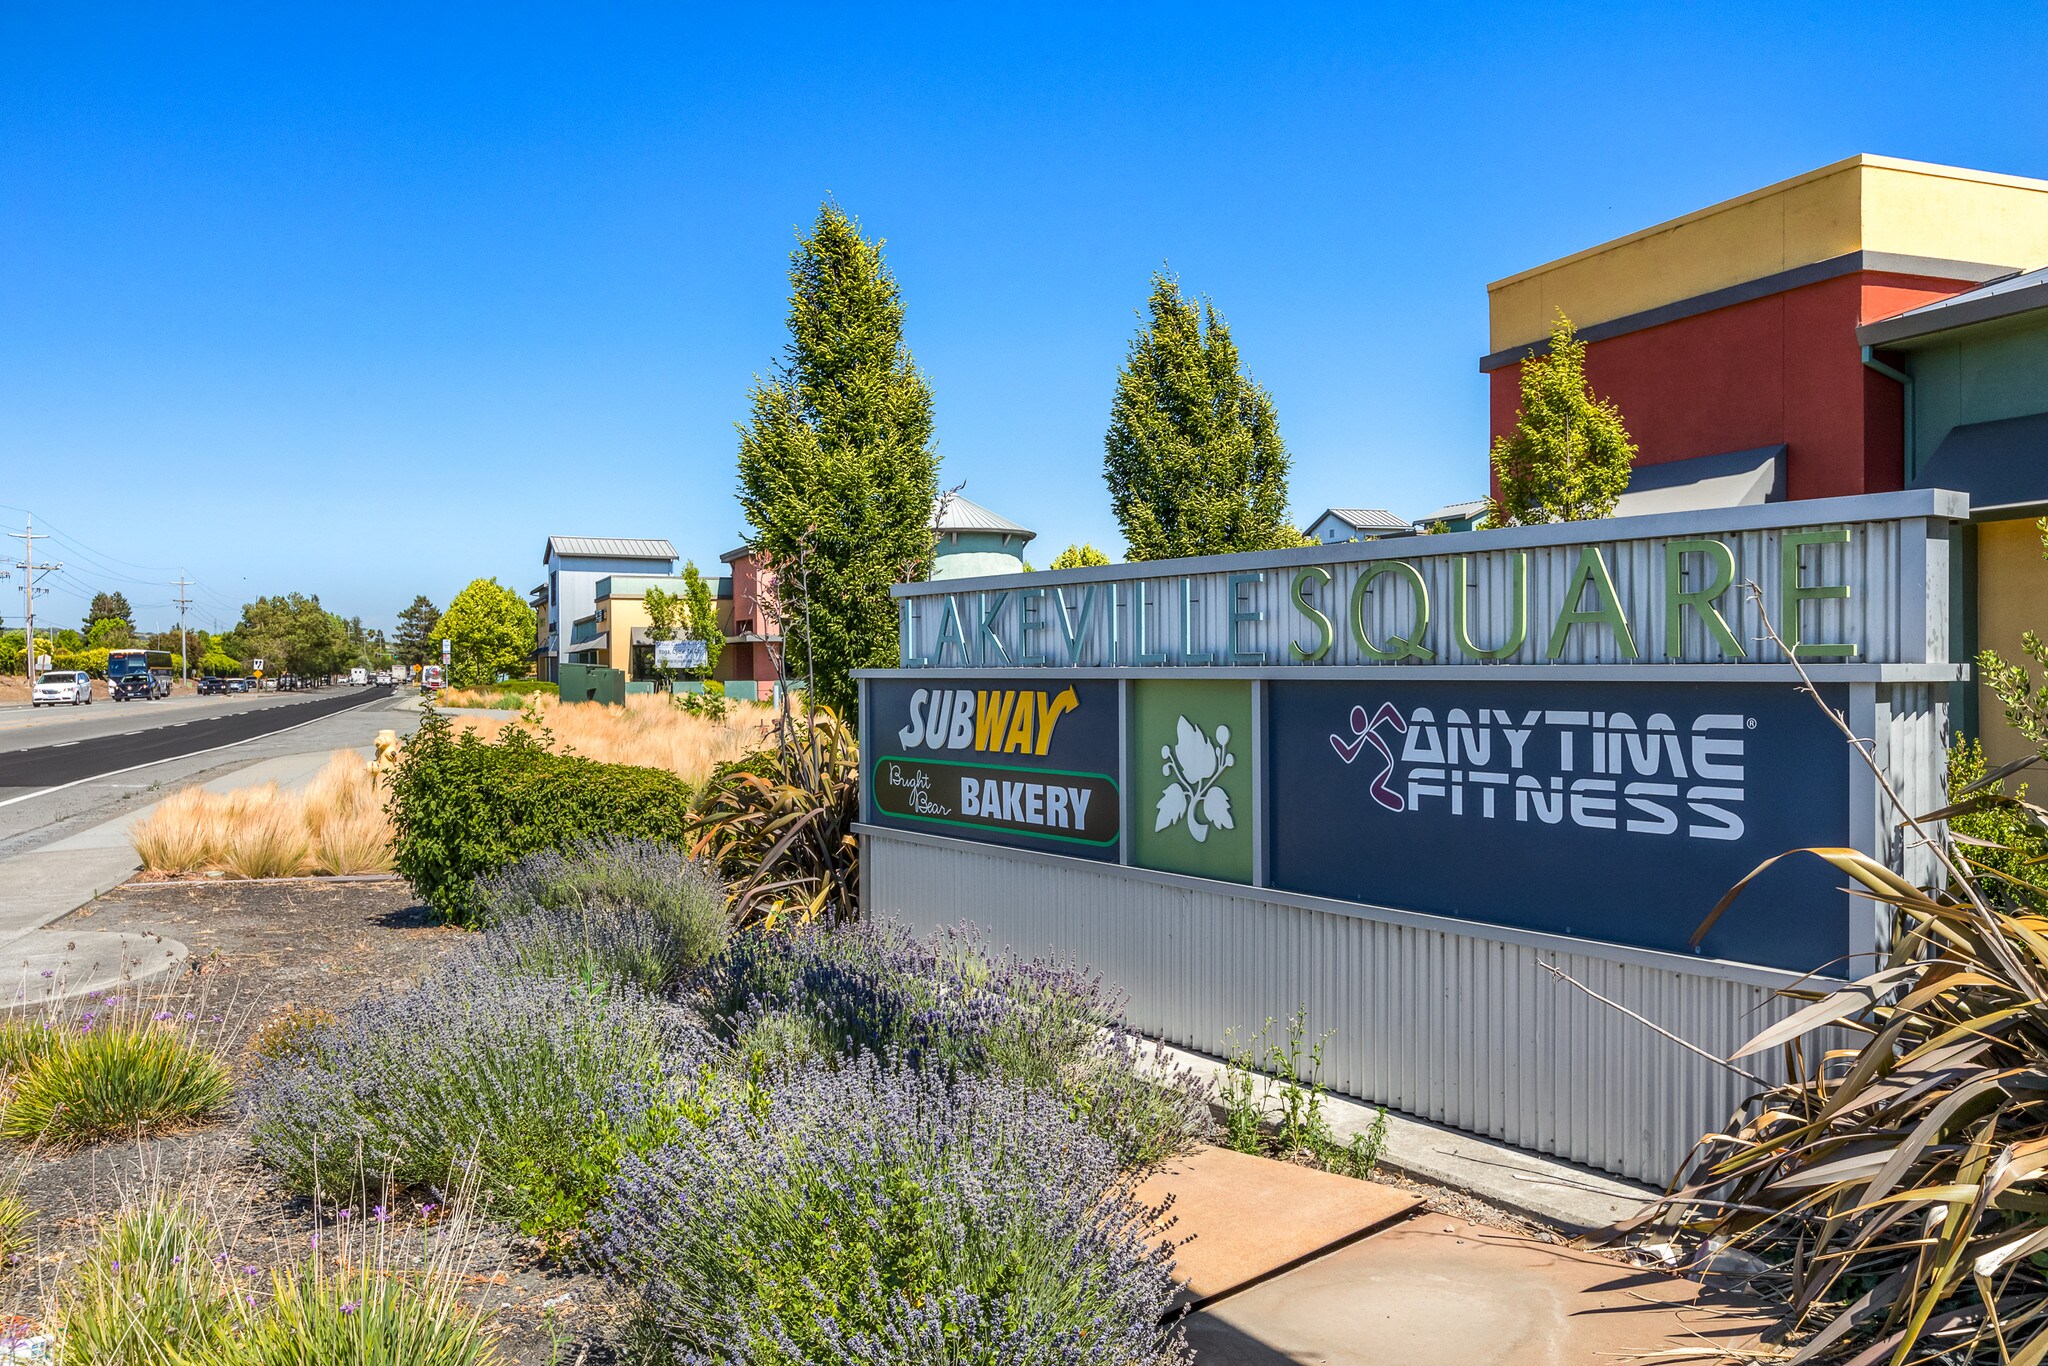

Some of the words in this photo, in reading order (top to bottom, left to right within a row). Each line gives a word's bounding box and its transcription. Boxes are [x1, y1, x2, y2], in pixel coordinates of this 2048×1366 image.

[904, 573, 1268, 666] LAKEVILLE
[1288, 529, 1858, 661] SQUARE
[898, 683, 1080, 756] SUBWAY
[1401, 707, 1744, 781] ANYTIME
[914, 790, 952, 816] Bear
[960, 776, 1092, 831] BAKERY
[1408, 768, 1745, 841] FITNESS
